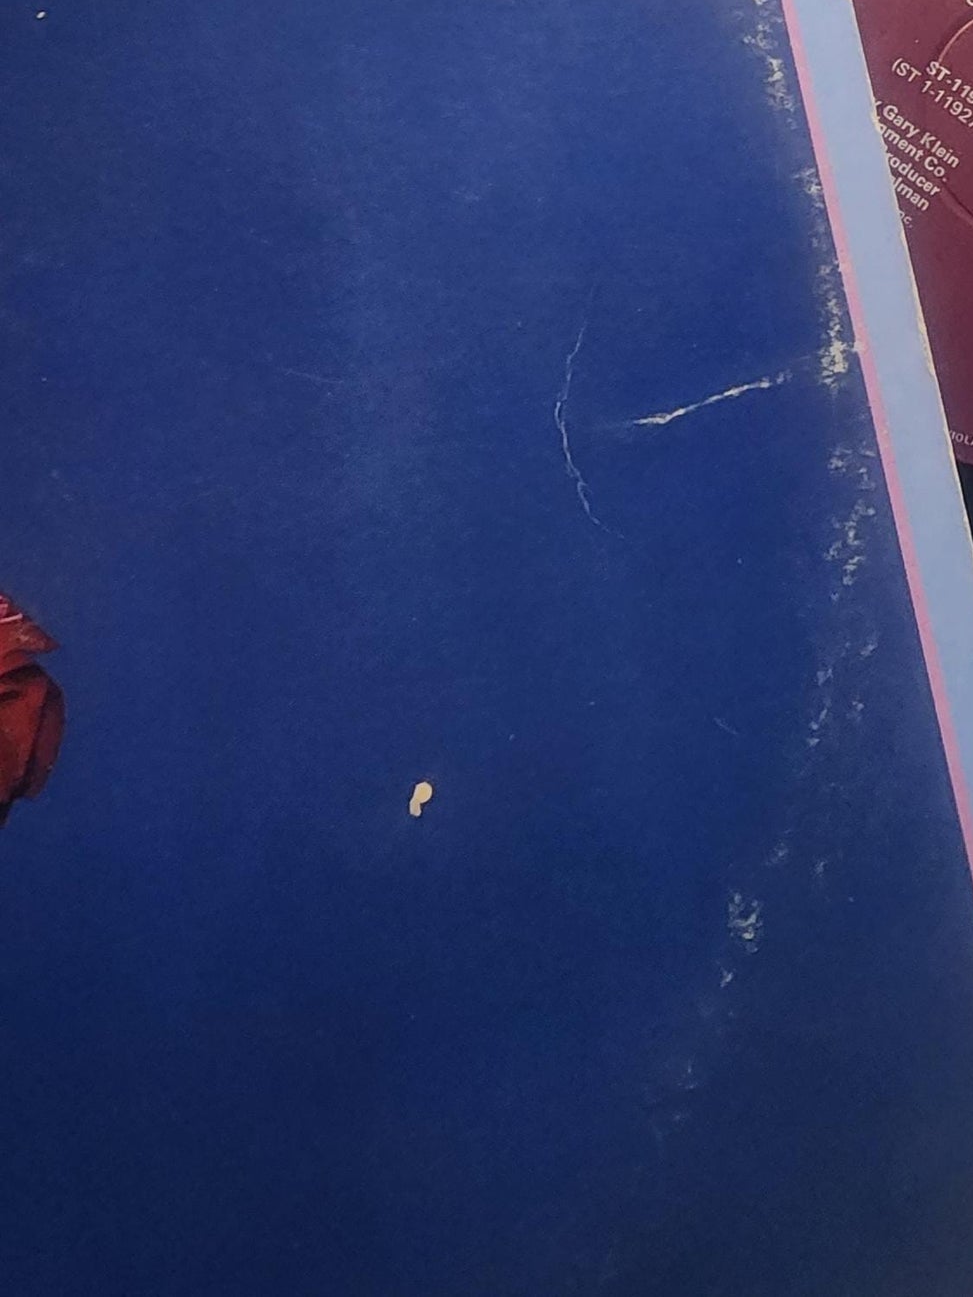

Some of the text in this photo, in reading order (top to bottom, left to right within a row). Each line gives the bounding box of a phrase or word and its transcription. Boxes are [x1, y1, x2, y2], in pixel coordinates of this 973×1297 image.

[891, 58, 922, 83] (ST
[883, 105, 960, 169] Gary Klein
[924, 156, 947, 182] Co.
[894, 177, 930, 211] lman
